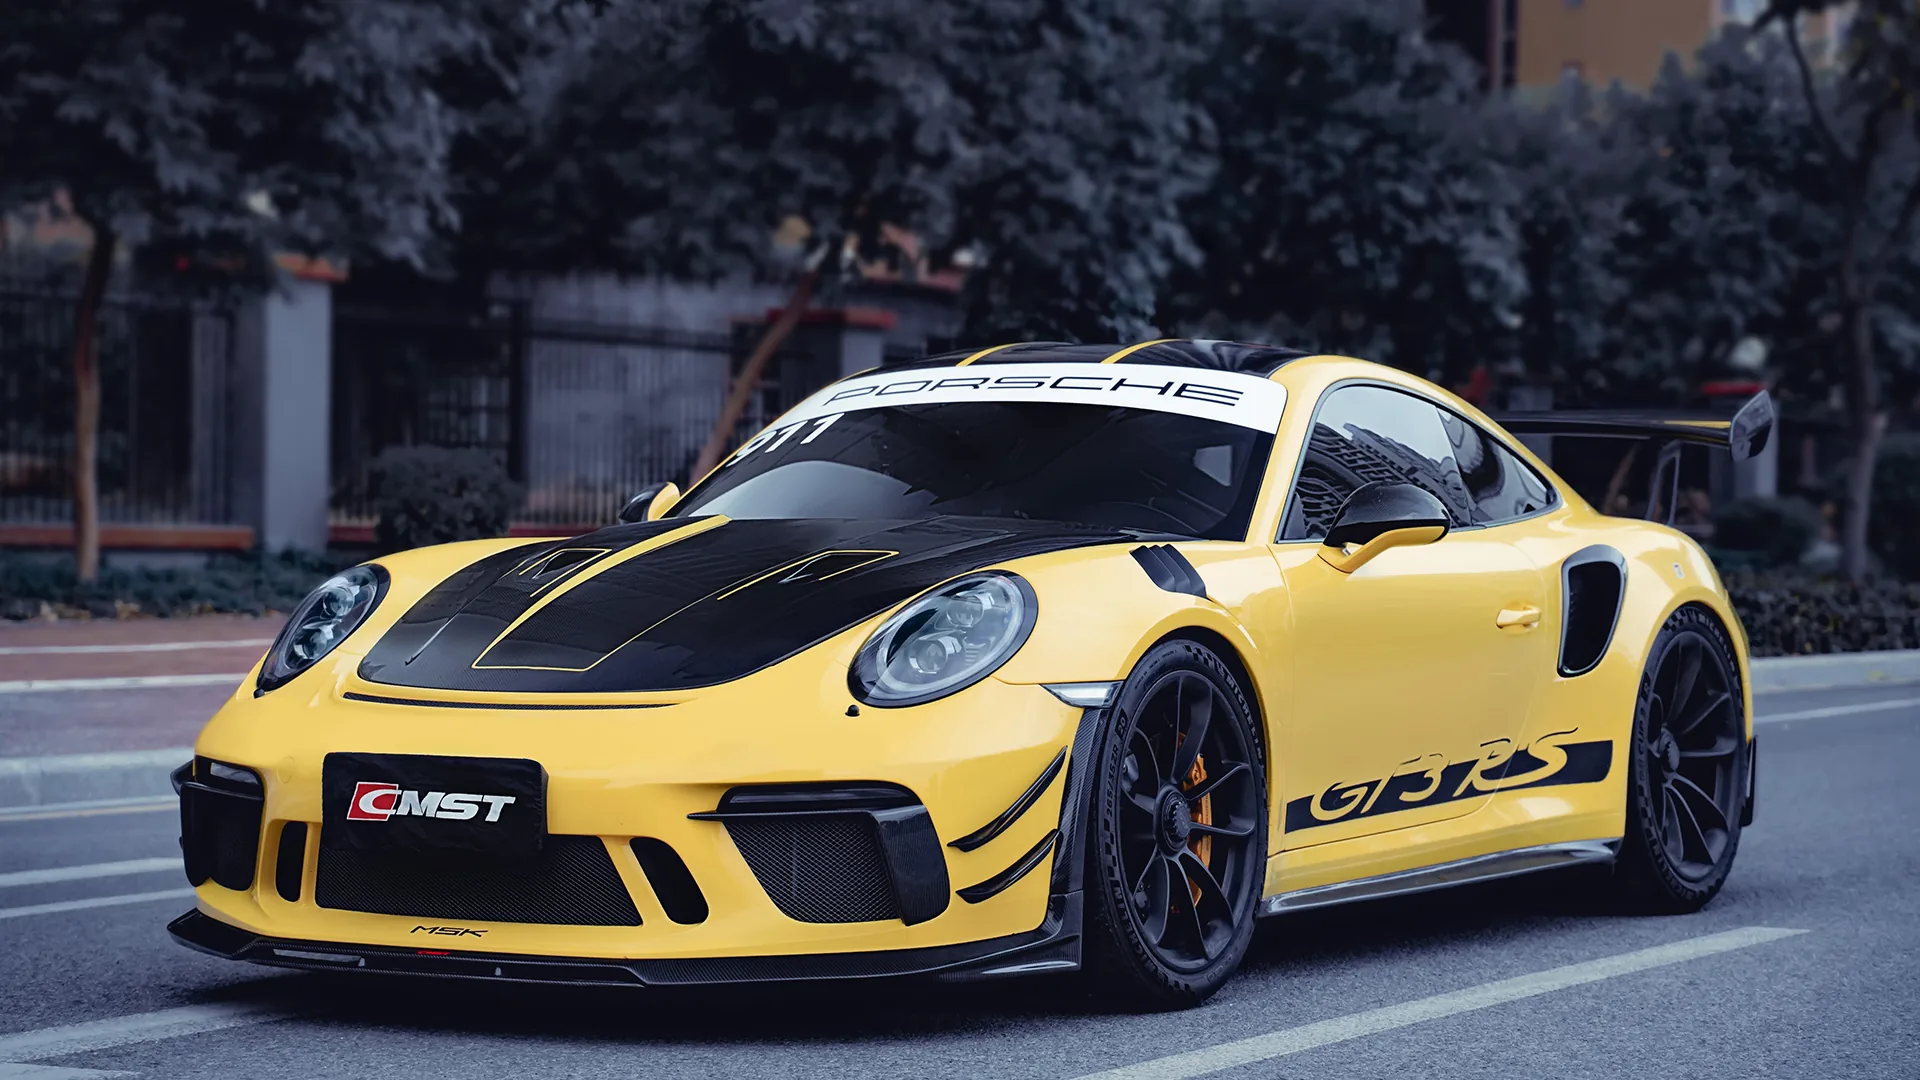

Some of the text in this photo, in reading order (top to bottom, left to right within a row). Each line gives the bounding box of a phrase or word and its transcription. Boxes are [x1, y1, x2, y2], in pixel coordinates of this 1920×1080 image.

[823, 376, 1244, 407] PORSCHE
[726, 412, 845, 467] 911
[1226, 676, 1263, 760] MICHELIN
[1105, 716, 1126, 818] 265/35ZR 20
[1310, 727, 1579, 821] GT3 RS
[358, 789, 516, 822] CMST
[410, 926, 488, 938] MSK
